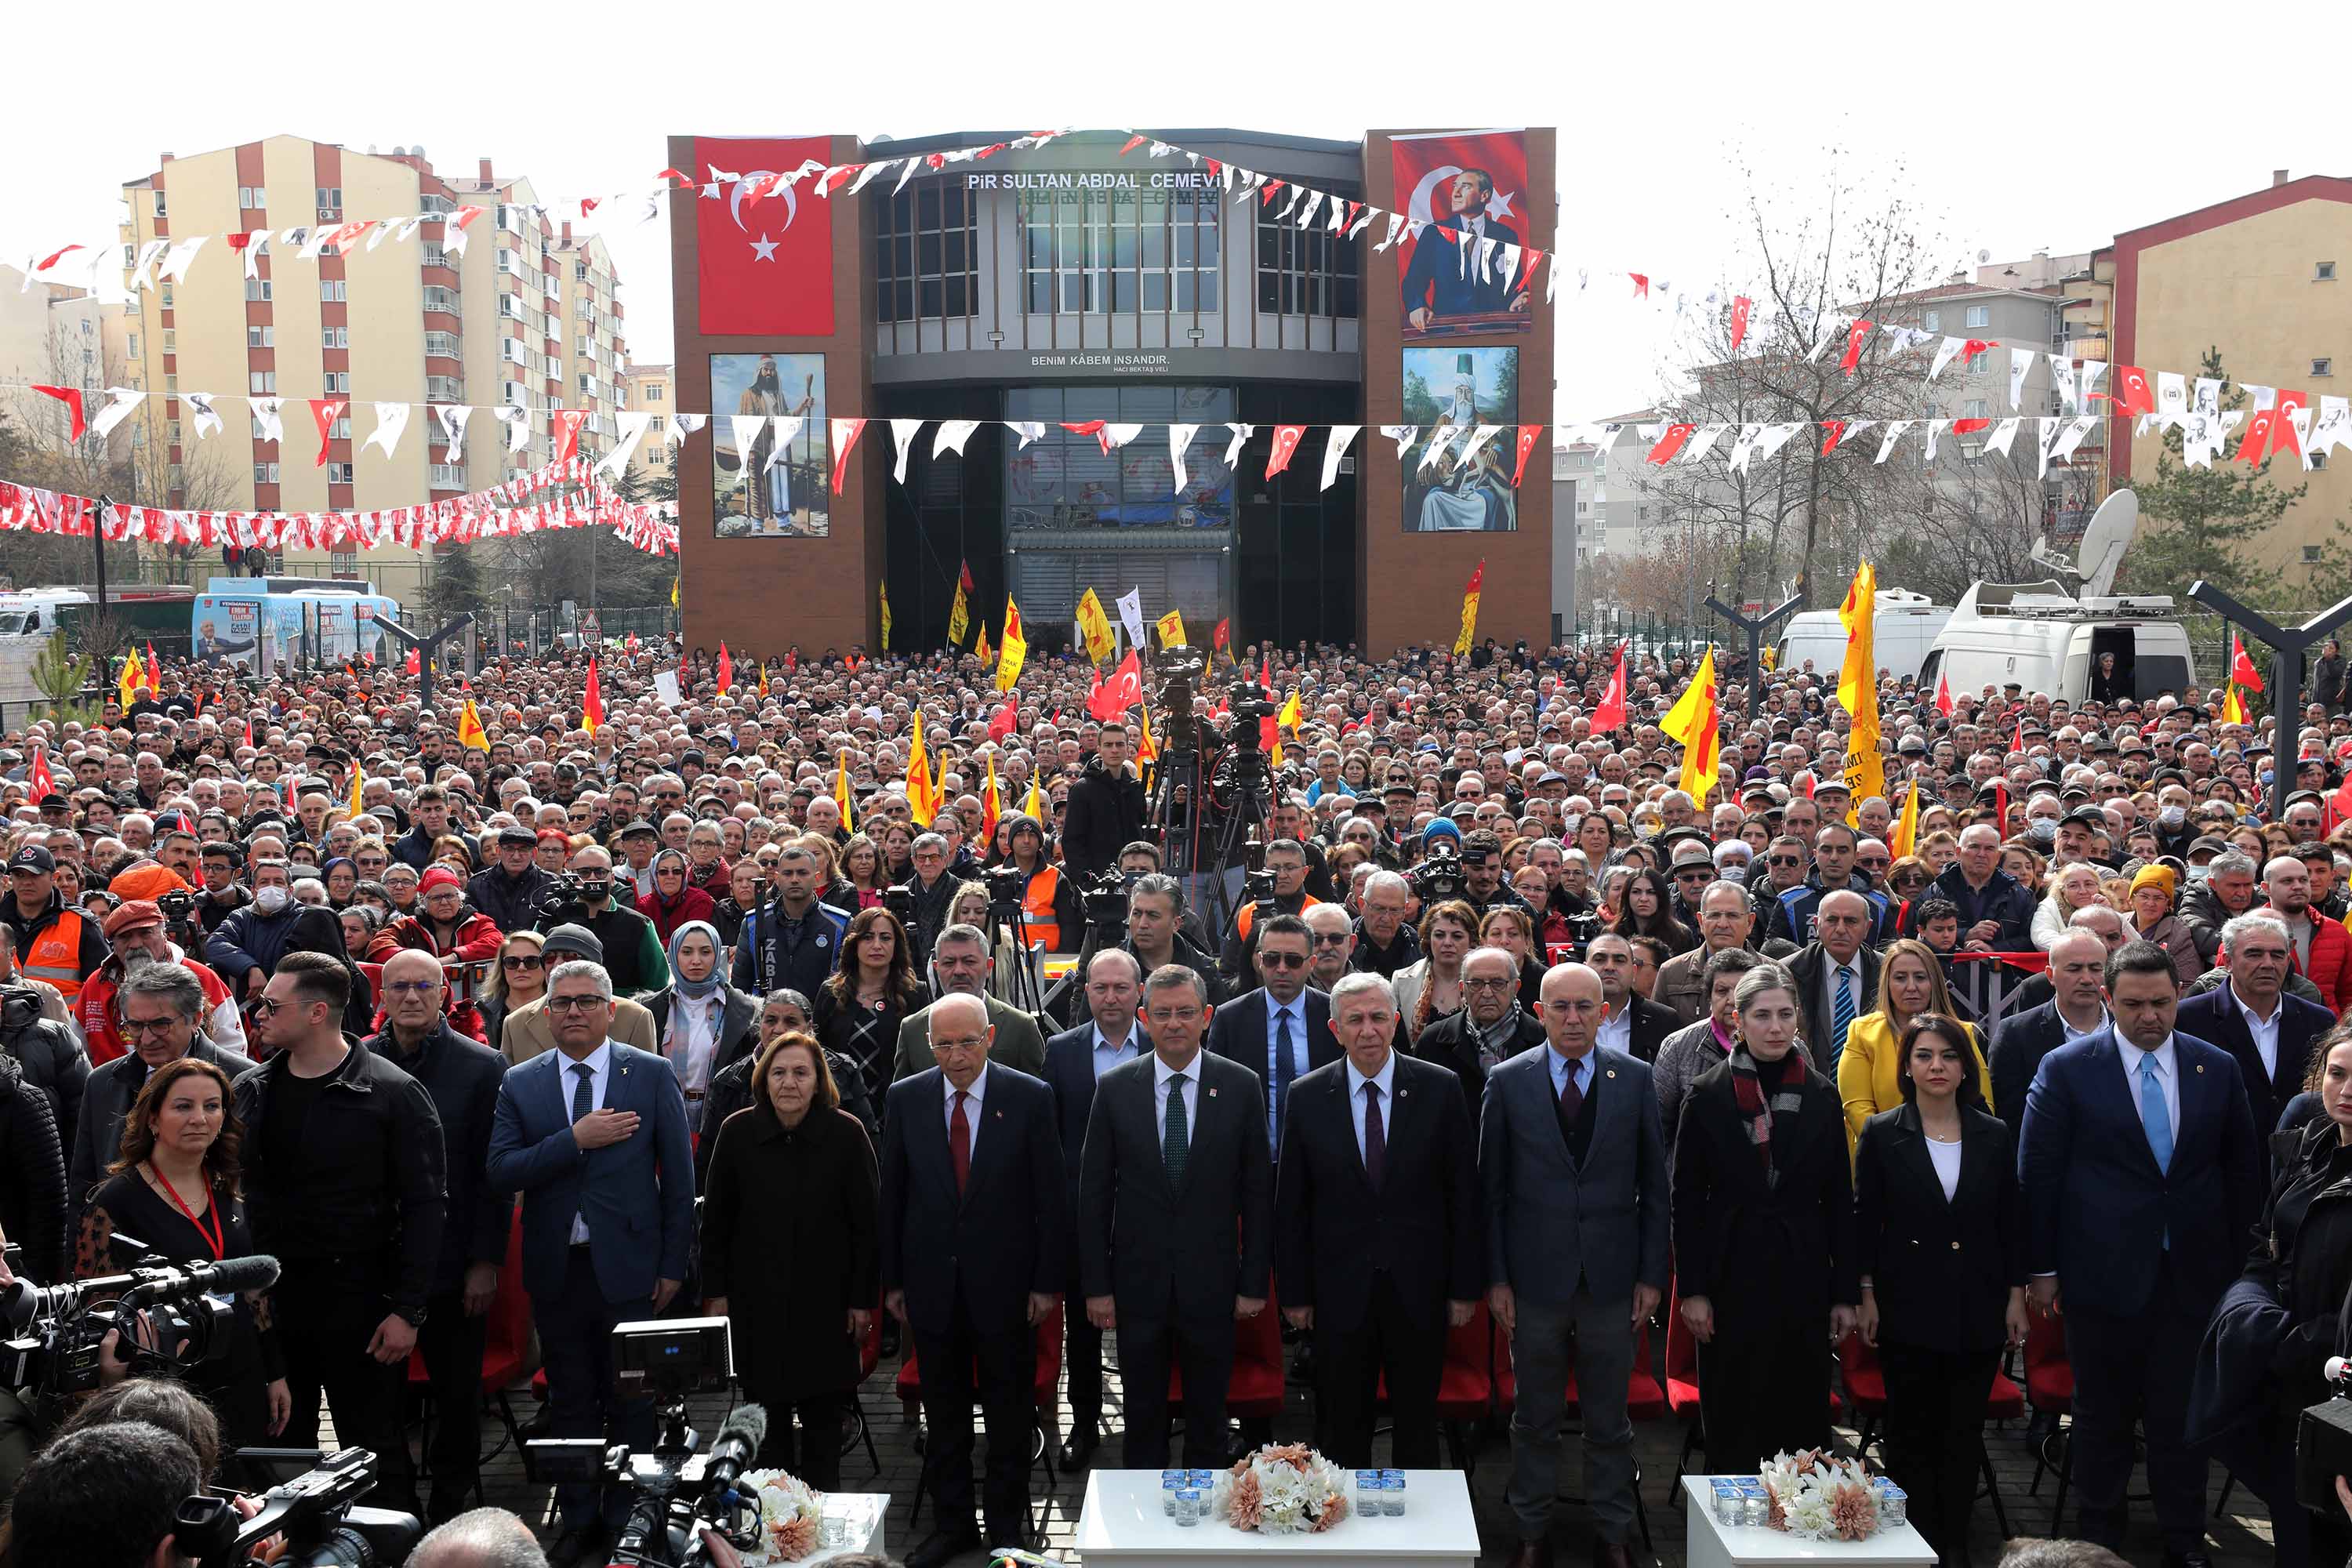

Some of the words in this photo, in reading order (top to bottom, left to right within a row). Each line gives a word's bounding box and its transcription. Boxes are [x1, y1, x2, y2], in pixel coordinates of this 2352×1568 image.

[1002, 173, 1072, 189] SULTAN
[1076, 173, 1140, 189] ABDAL
[1070, 353, 1111, 365] KÂBEM
[587, 633, 596, 642] 30
